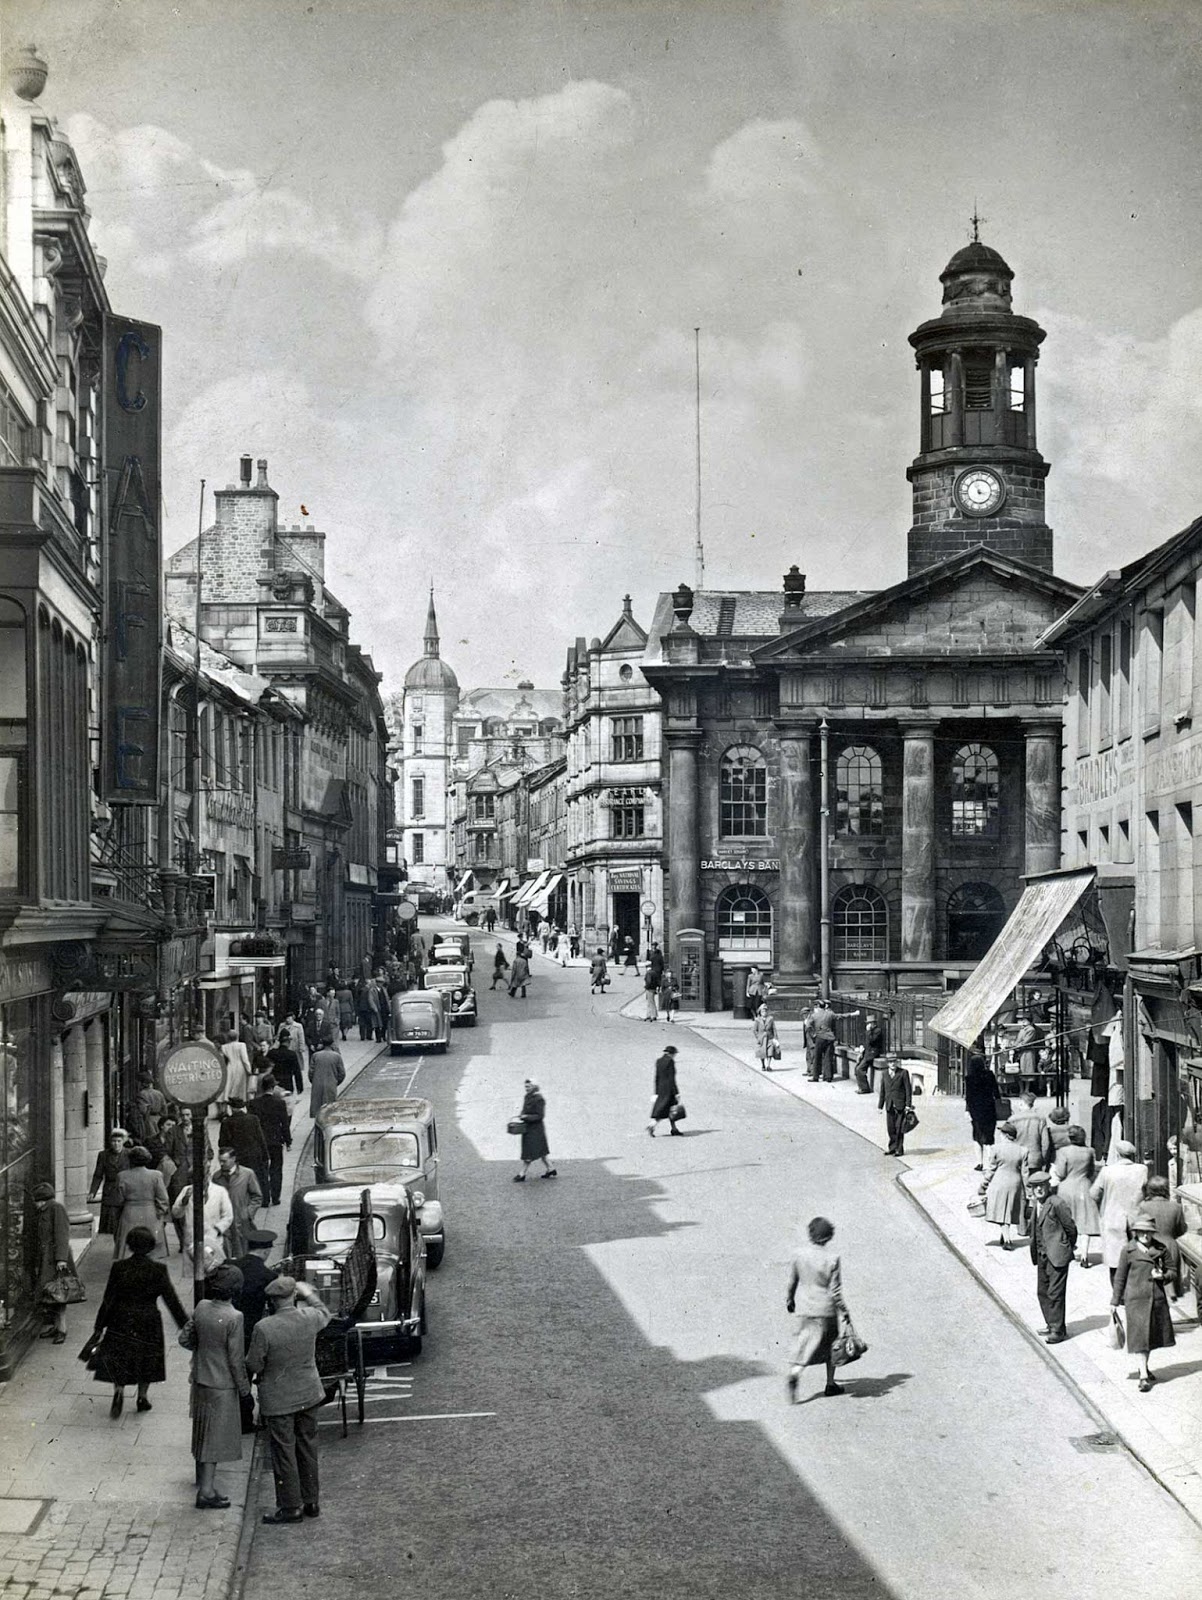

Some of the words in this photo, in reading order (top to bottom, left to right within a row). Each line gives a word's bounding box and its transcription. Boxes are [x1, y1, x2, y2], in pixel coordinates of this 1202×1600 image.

[700, 860, 756, 870] BARCLAYS
[166, 1058, 221, 1074] WAITING
[165, 1069, 222, 1085] RESTRICTED
